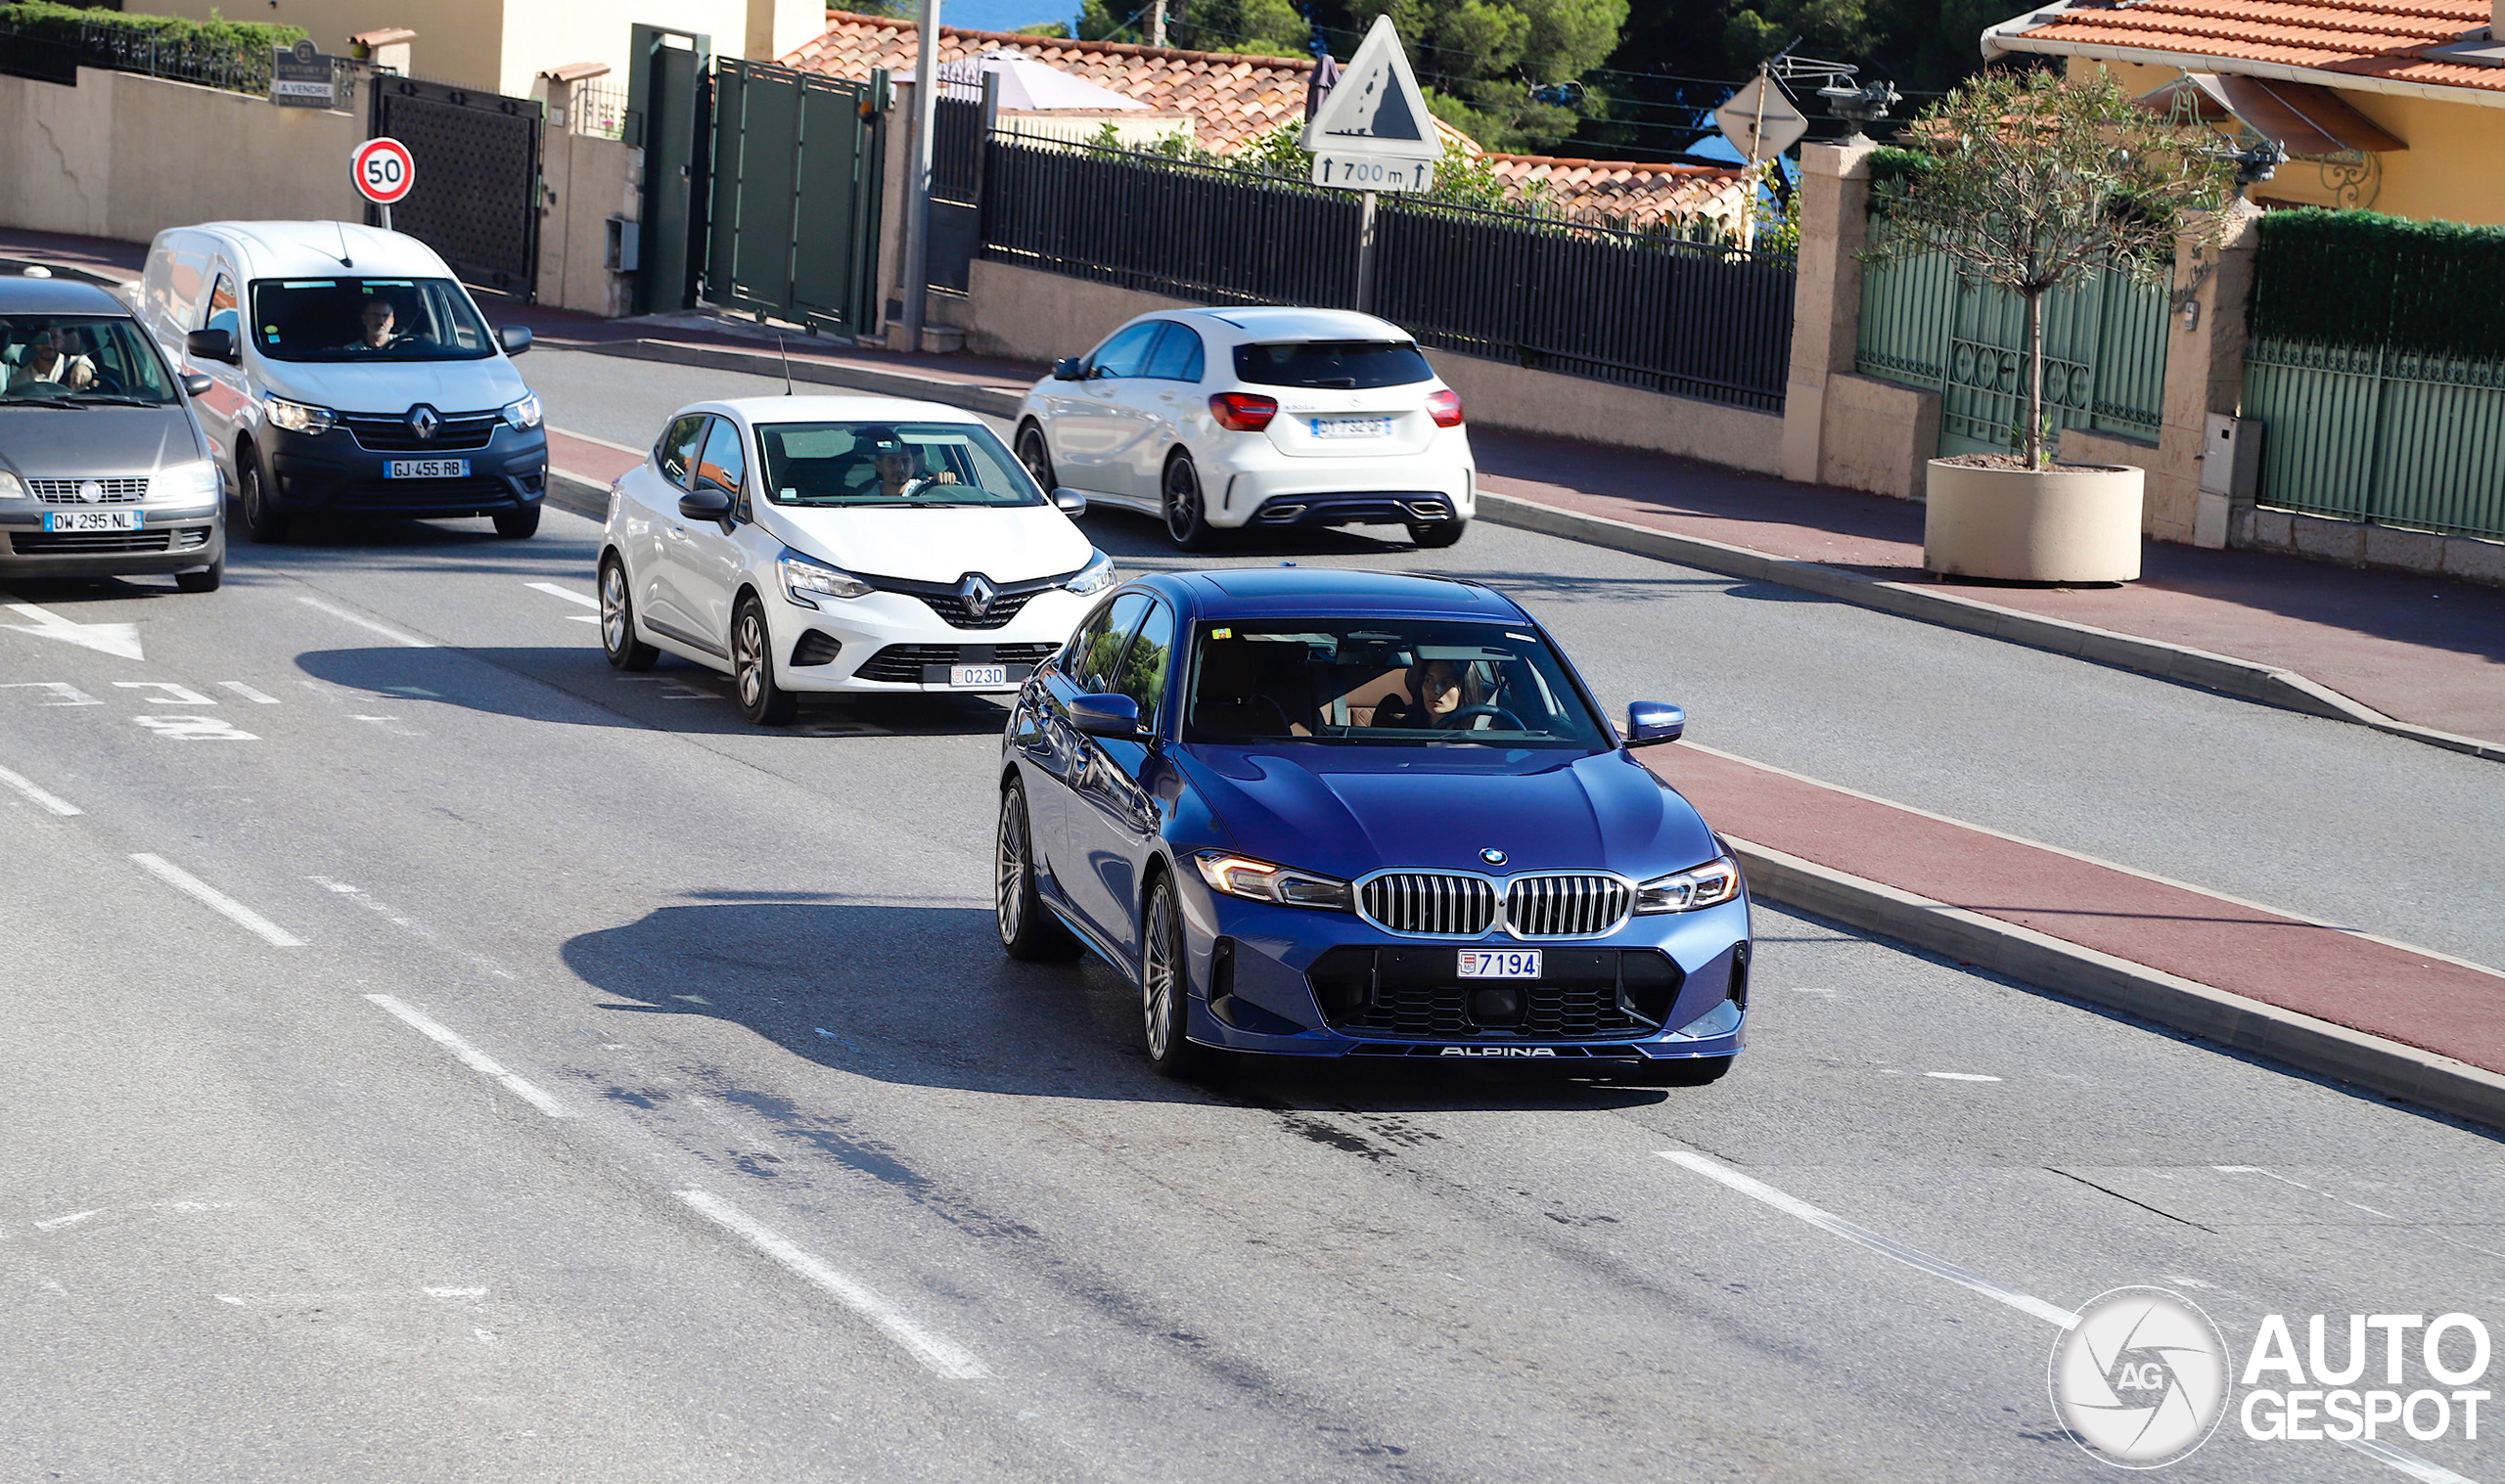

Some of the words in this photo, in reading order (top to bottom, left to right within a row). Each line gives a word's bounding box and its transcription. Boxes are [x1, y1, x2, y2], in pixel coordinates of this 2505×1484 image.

[290, 84, 330, 96] VENDRE
[368, 158, 400, 184] 50
[1344, 162, 1384, 182] 700
[1388, 170, 1403, 184] m
[393, 462, 460, 476] GJ-455-RB
[55, 513, 131, 529] DW-295-NL
[965, 668, 1002, 684] 023D
[1480, 954, 1536, 975] 7194
[1439, 1046, 1557, 1057] ALPINA
